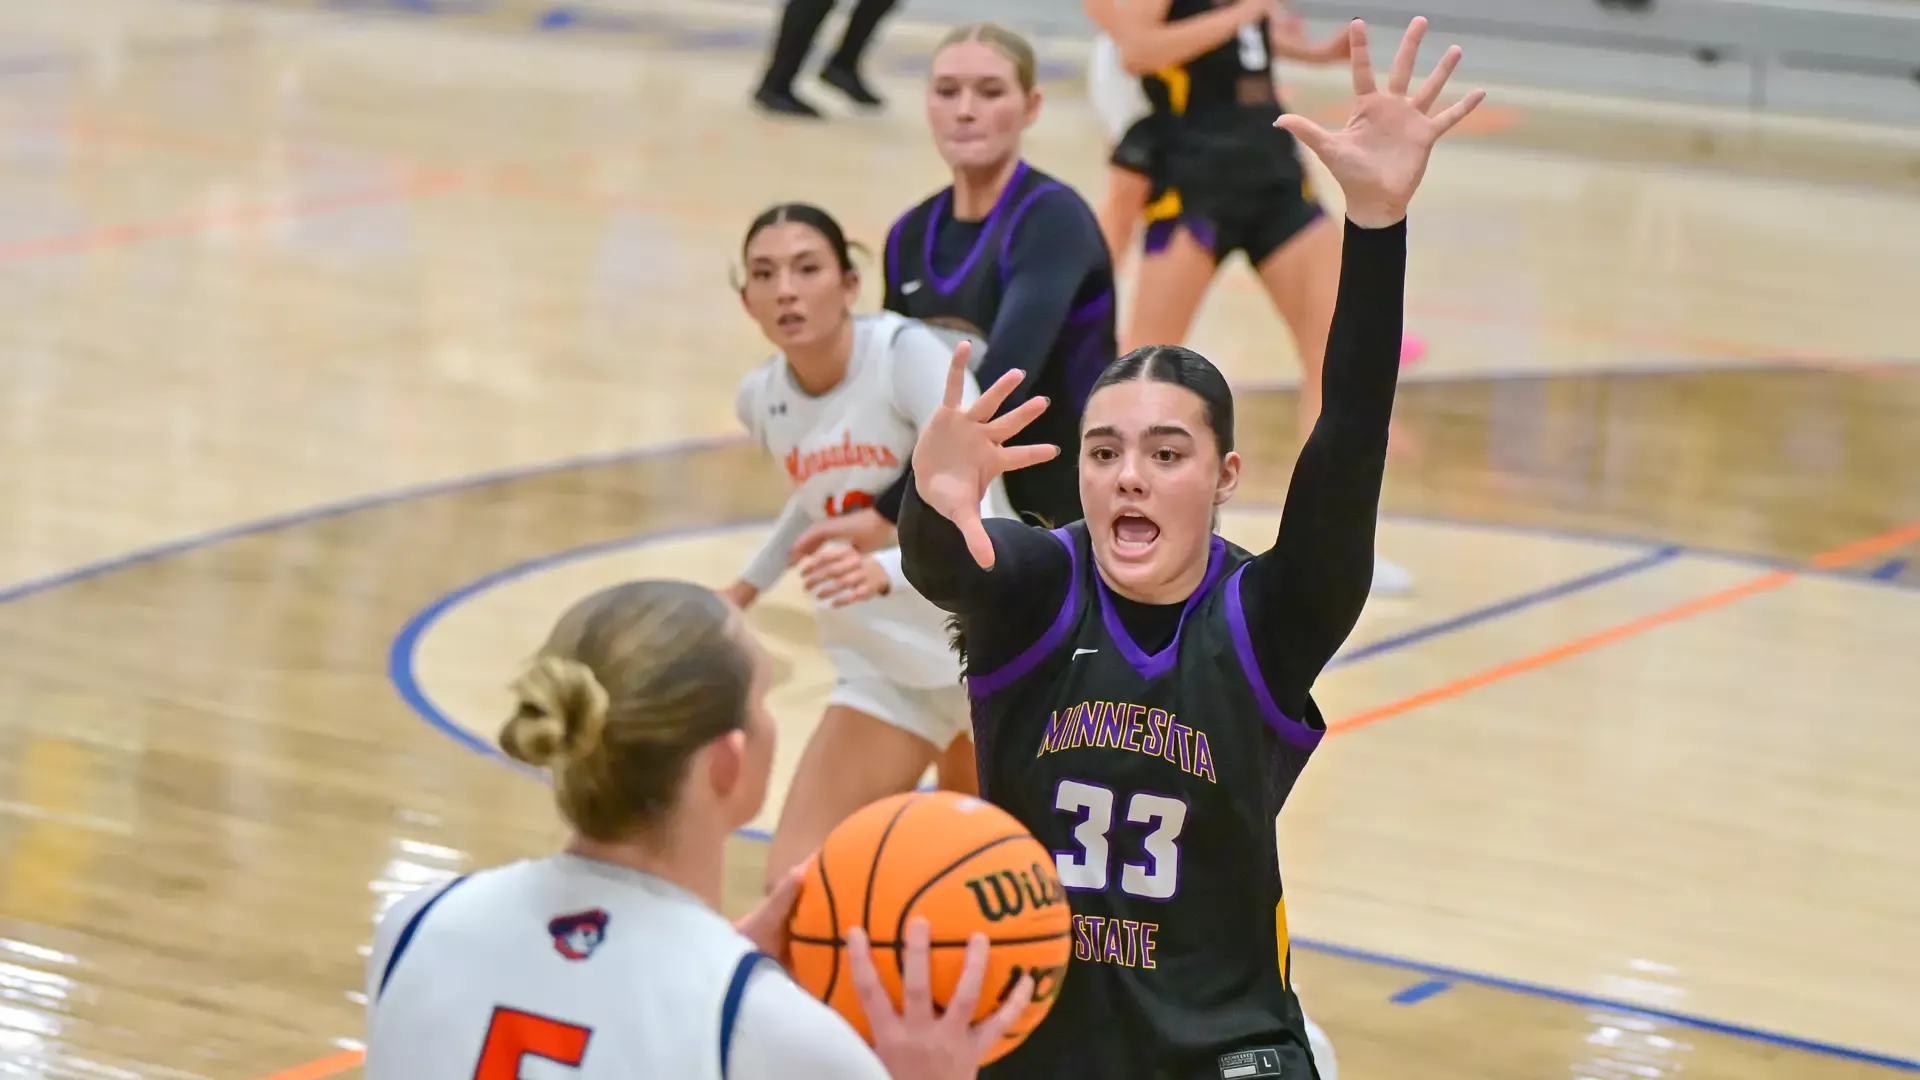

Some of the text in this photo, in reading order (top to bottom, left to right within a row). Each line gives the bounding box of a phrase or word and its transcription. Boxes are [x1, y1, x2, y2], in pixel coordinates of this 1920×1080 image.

[1054, 779, 1189, 901] 33
[1072, 914, 1159, 969] STATE
[1263, 1056, 1272, 1067] L
